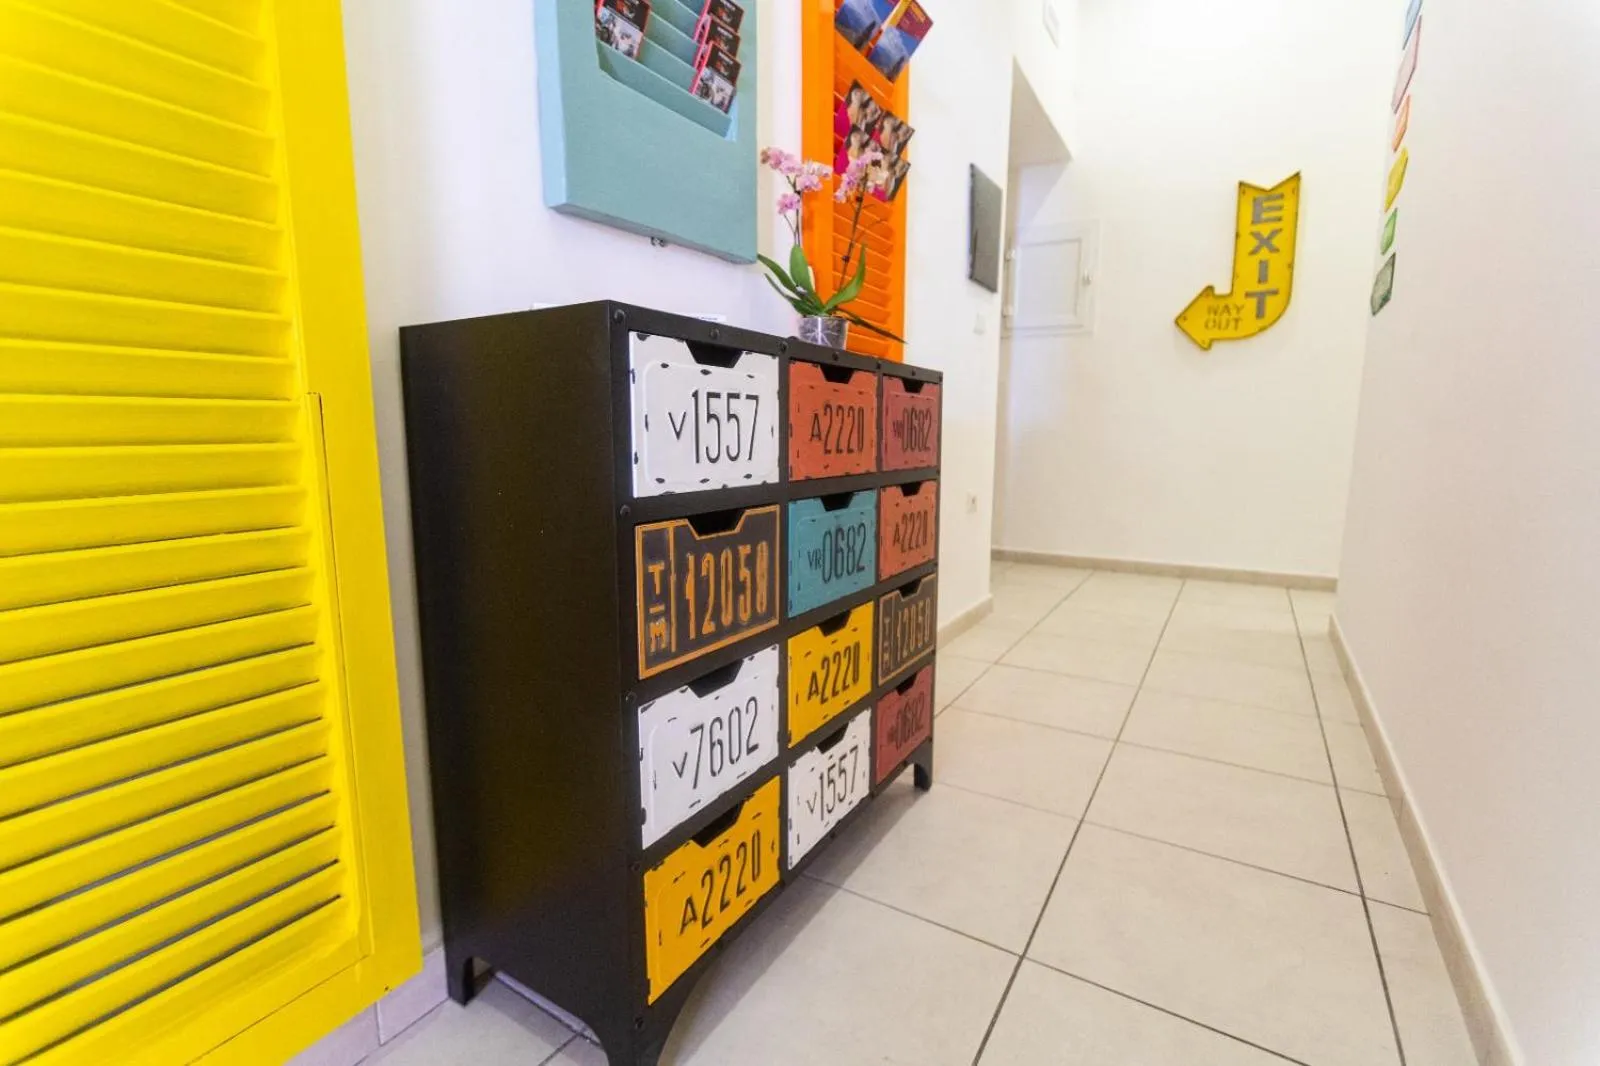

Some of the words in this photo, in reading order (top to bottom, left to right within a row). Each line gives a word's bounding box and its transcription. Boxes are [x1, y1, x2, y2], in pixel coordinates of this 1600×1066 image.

[1245, 193, 1285, 320] EXIT
[1206, 303, 1245, 316] WAY
[1204, 317, 1243, 331] OUT
